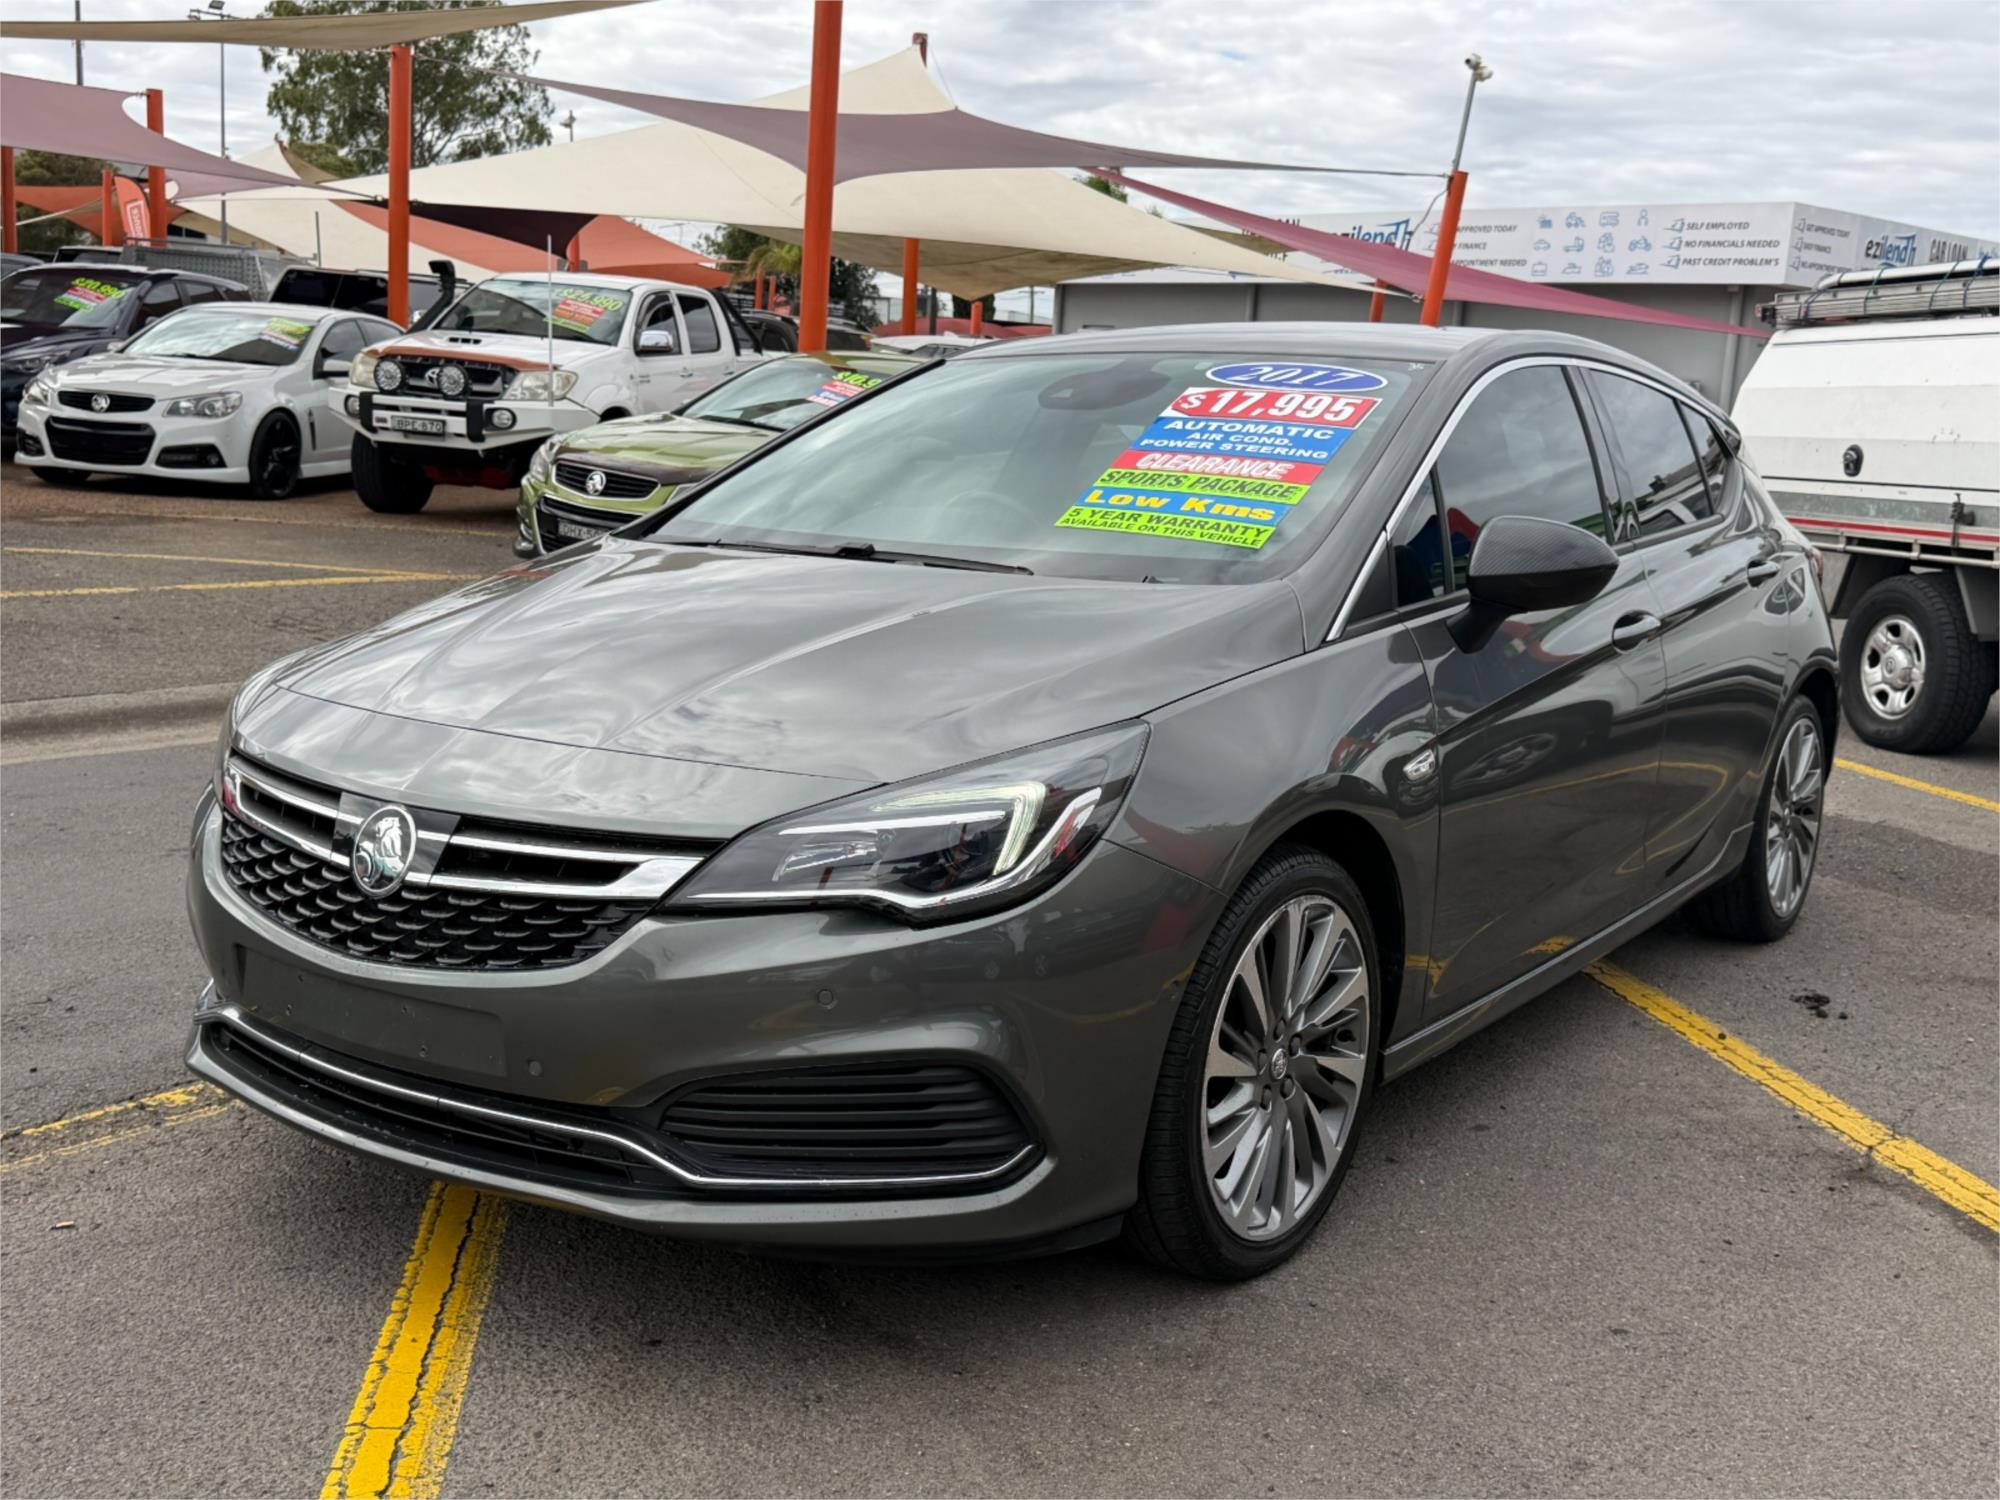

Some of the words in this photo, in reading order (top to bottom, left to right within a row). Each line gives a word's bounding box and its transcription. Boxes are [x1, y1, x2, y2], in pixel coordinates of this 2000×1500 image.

[1686, 221, 1705, 230] SELF
[1705, 221, 1750, 231] EMPLOYED
[1683, 239, 1697, 248] NO
[1697, 239, 1745, 249] FINANCIALS
[1745, 239, 1780, 249] NEEDED
[1681, 257, 1701, 266] PAST
[1703, 257, 1731, 267] CREDIT
[1731, 257, 1780, 267] PROBLEM'S
[1226, 366, 1364, 386] 2017
[1163, 419, 1336, 440] AUTOMATIC
[1186, 432, 1225, 442] AIR
[1228, 433, 1294, 447] COND.
[1139, 438, 1215, 450] POWER
[1218, 442, 1329, 460] STEERING
[1136, 453, 1296, 480] CLEARANCE
[1101, 470, 1188, 488] SPORTS
[1187, 476, 1300, 499] PACKAGE
[1181, 497, 1276, 521] Kms
[1060, 517, 1135, 530] AVAILABLE
[1138, 523, 1159, 533] ON
[1163, 527, 1196, 537] THIS
[1200, 531, 1263, 546] VEHICLE
[1068, 508, 1081, 518] 5
[1087, 509, 1142, 523] YEAR
[1147, 514, 1268, 538] WARRANTY
